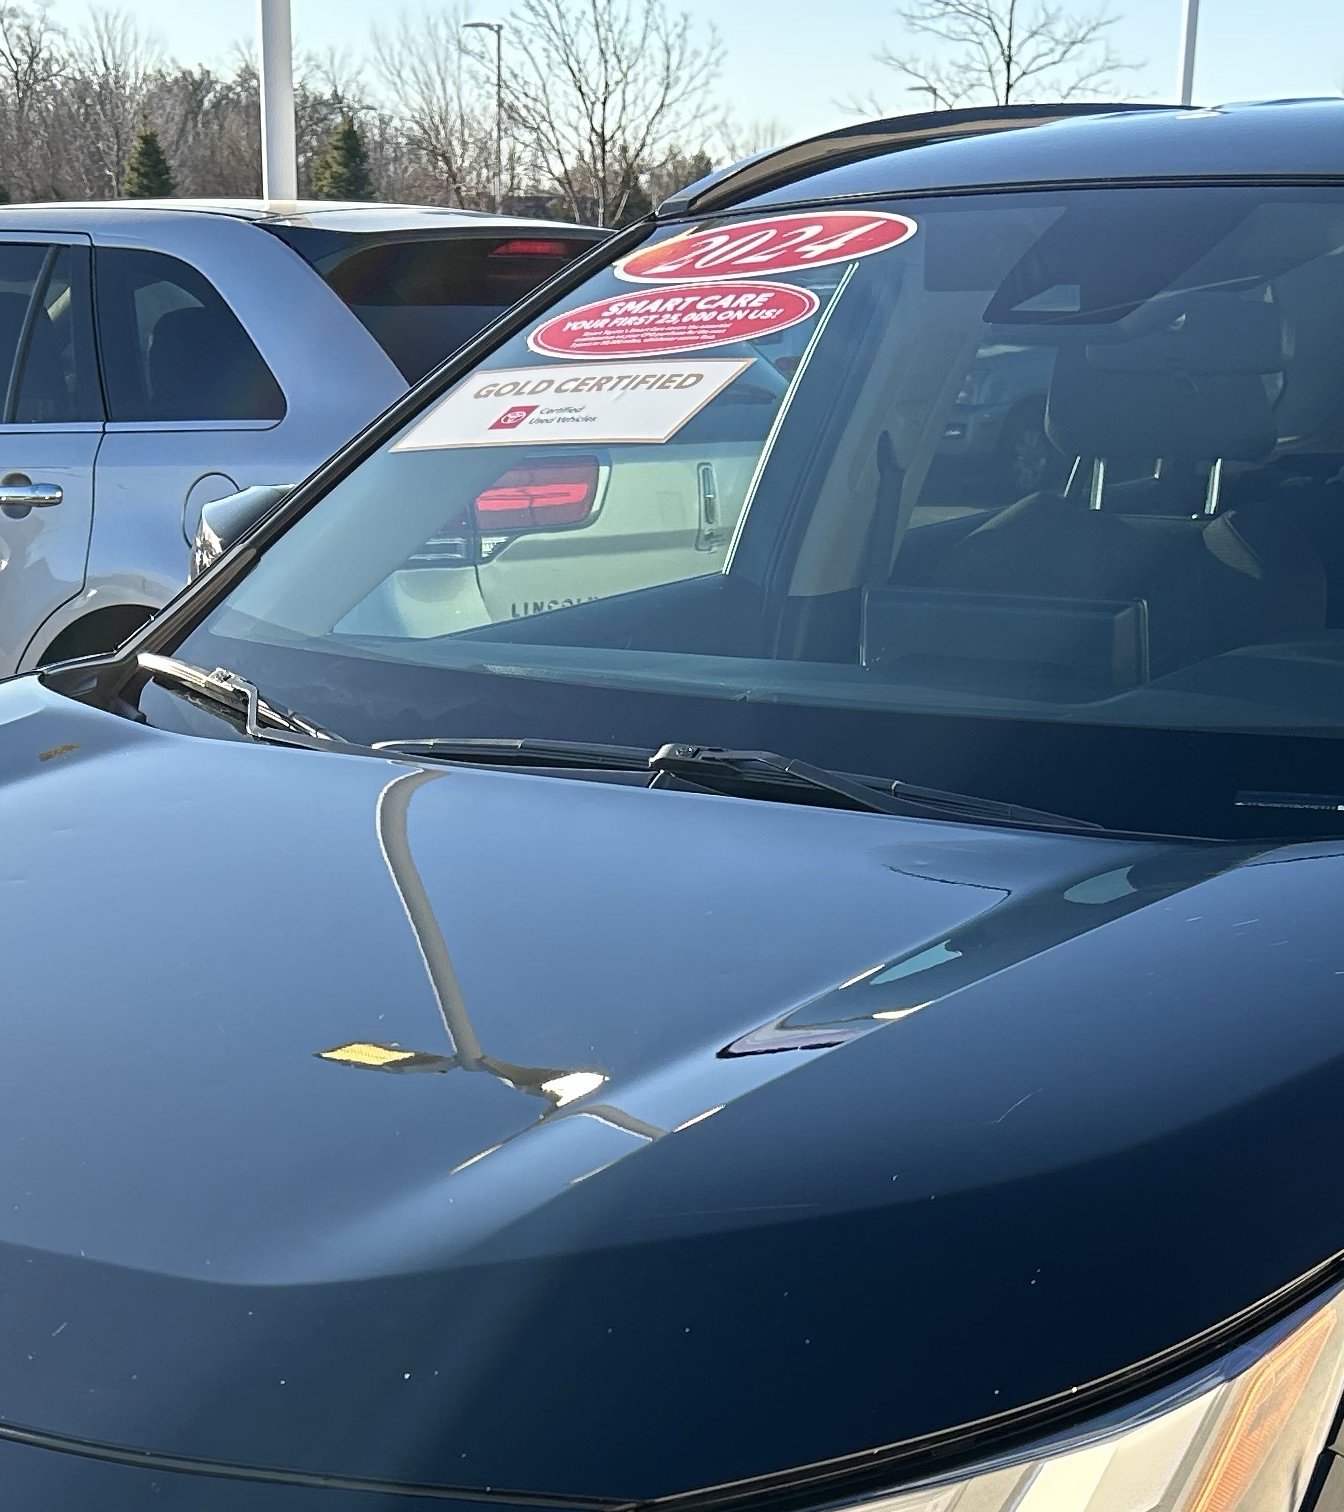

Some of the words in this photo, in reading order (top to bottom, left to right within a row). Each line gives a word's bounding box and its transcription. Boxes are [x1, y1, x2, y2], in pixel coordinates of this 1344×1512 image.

[641, 219, 888, 275] 2024
[601, 295, 700, 317] SMART
[695, 292, 775, 309] CARE
[562, 317, 613, 332] YOUR
[609, 313, 662, 327] FIRST
[718, 309, 752, 320] ON
[751, 308, 784, 319] US!
[473, 379, 555, 400] GOLD
[554, 373, 704, 394] CERTIFIED
[539, 405, 586, 414] Certified
